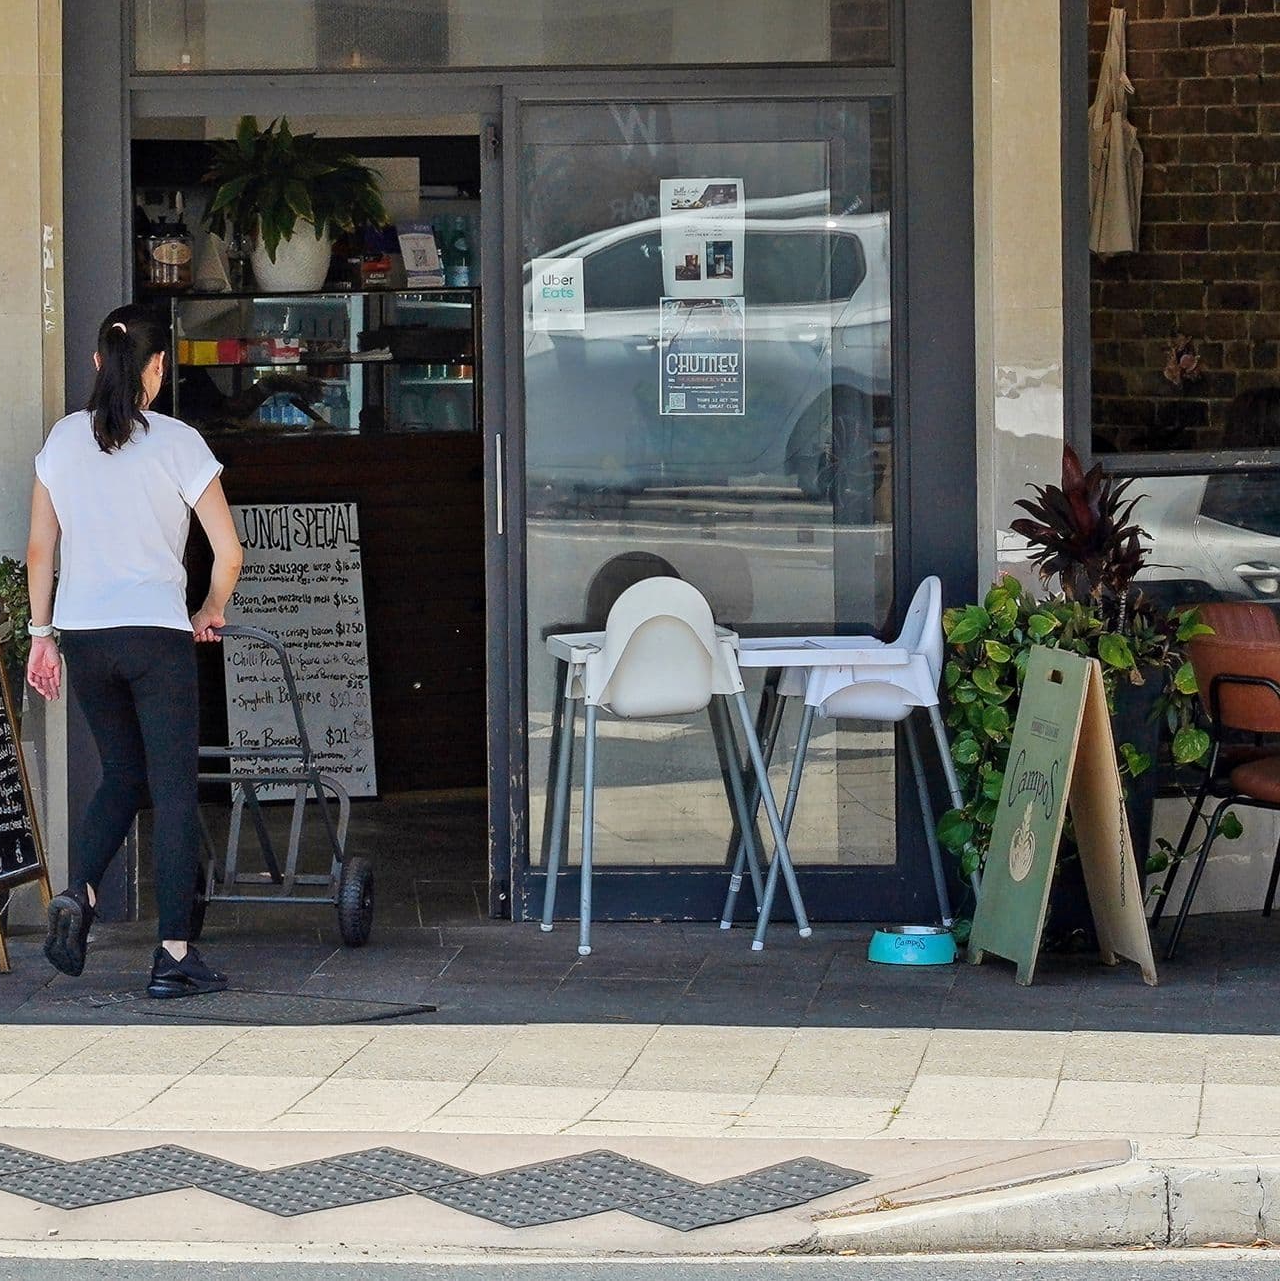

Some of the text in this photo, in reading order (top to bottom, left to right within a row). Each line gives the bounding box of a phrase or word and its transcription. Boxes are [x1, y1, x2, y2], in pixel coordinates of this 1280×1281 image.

[542, 274, 574, 286] Uber
[542, 287, 575, 298] Eats
[666, 352, 739, 375] CHUTNEY
[240, 503, 360, 552] UNCH SPECIAL
[240, 562, 266, 576] orizo
[269, 561, 310, 579] sausage
[286, 627, 309, 639] crispy
[311, 625, 334, 635] bacon
[260, 650, 282, 666] Praw
[278, 686, 321, 712] Bognese
[236, 729, 260, 748] Penne
[325, 726, 350, 748] $21
[312, 751, 346, 761] ushroom,
[1007, 748, 1060, 821] Campos
[894, 936, 927, 951] Campos
